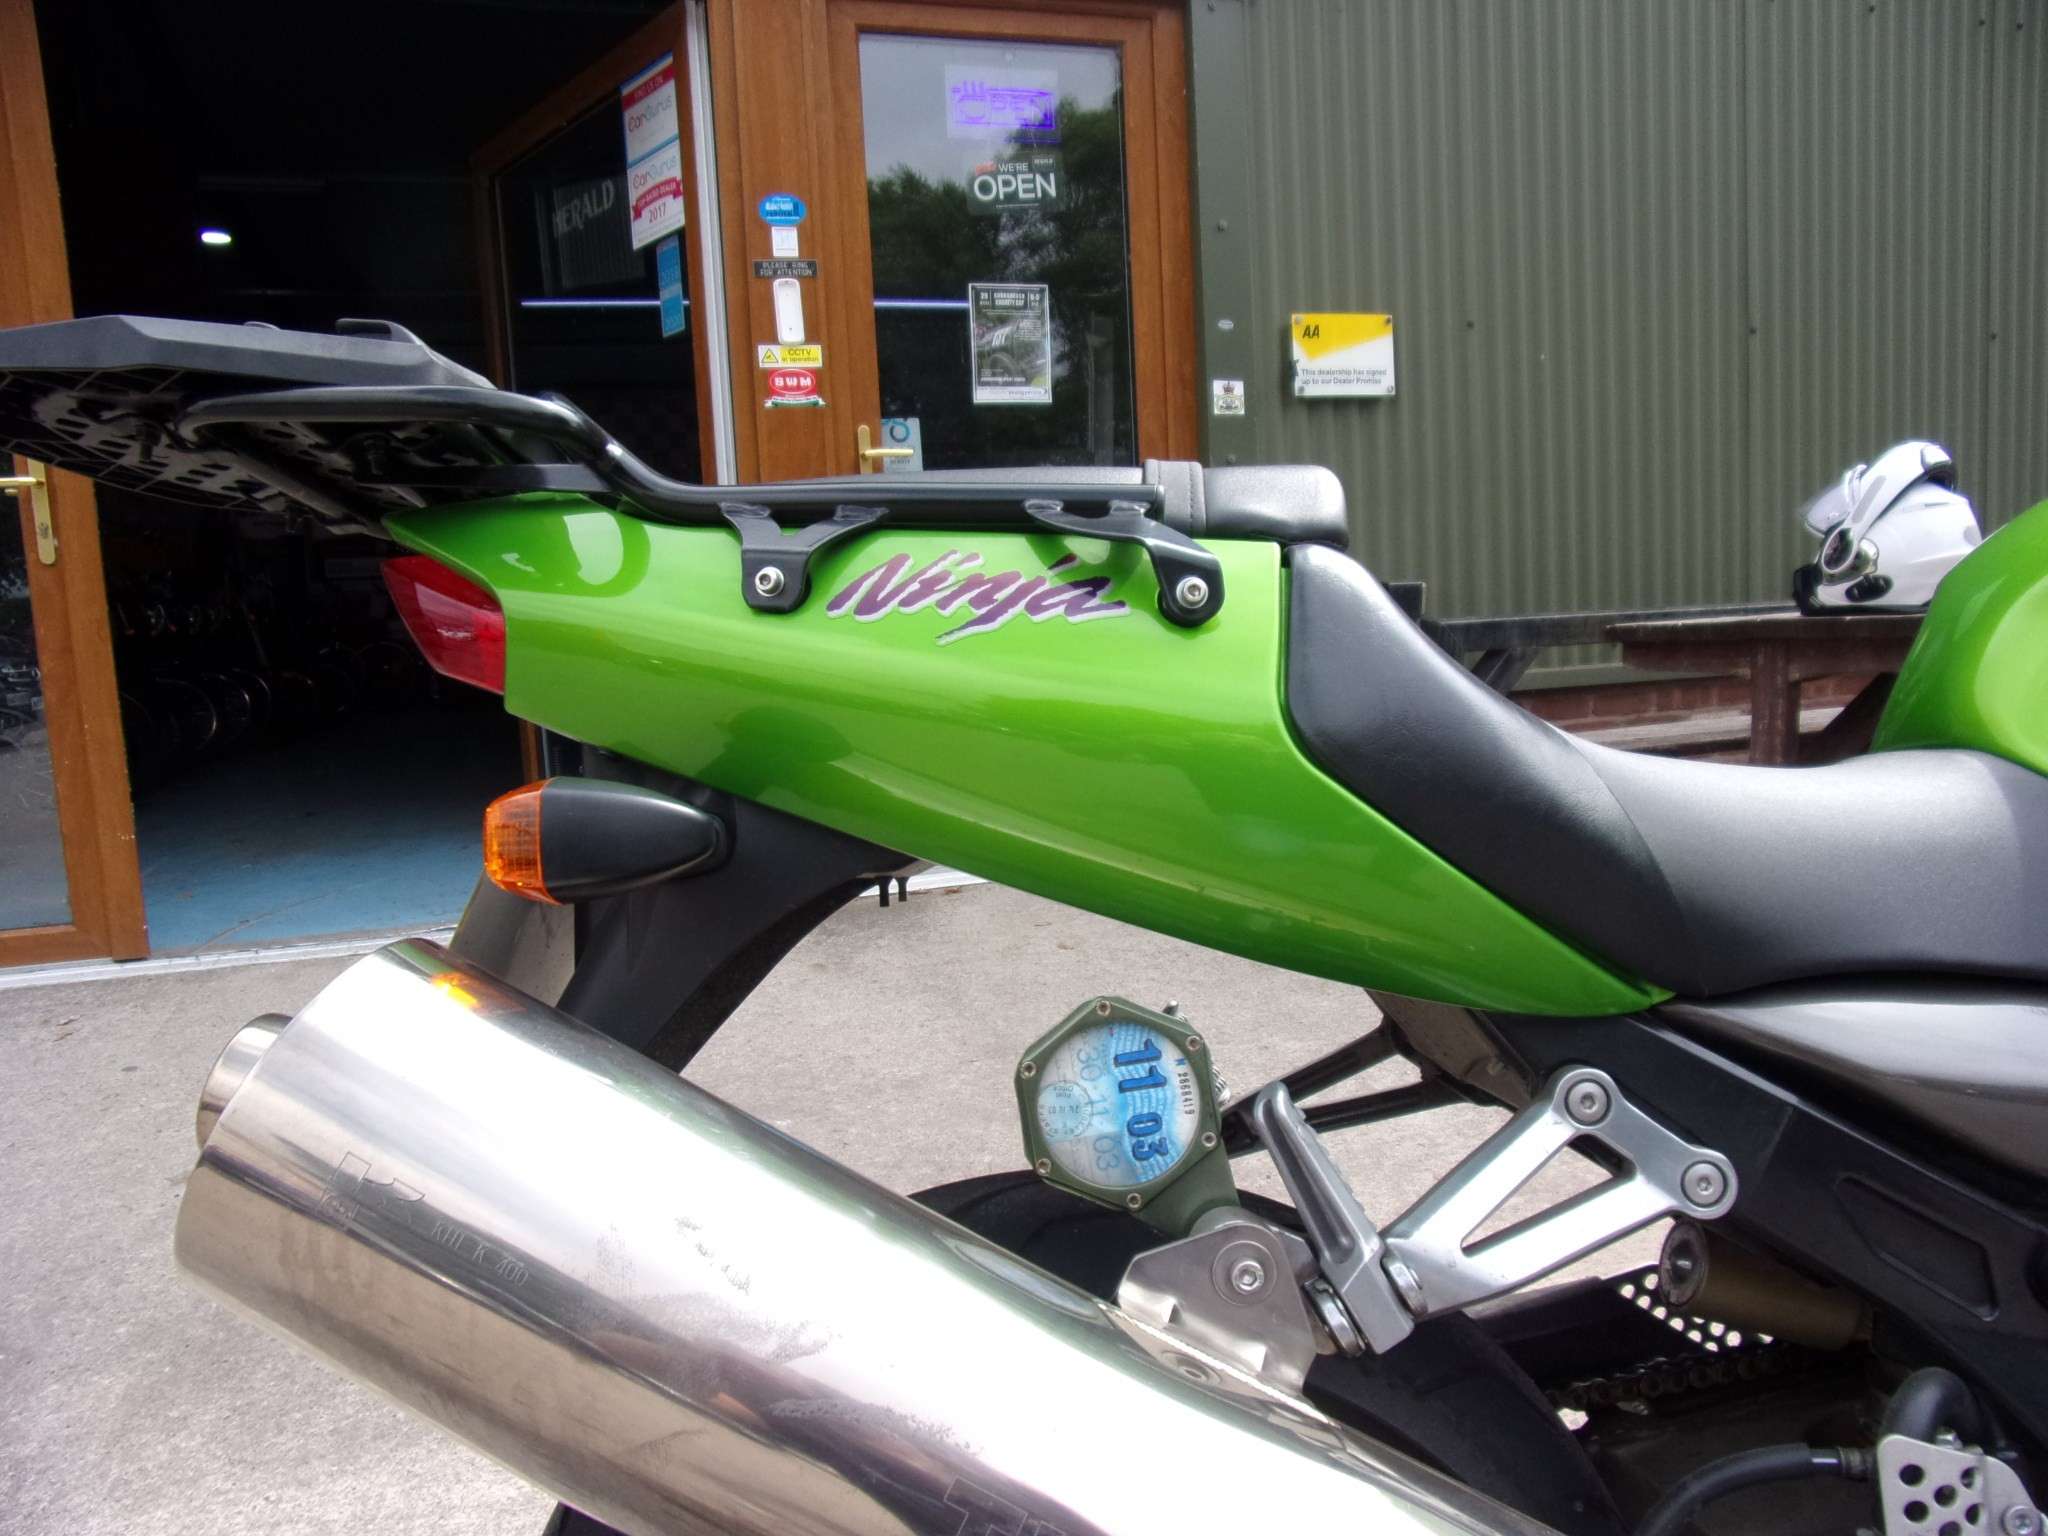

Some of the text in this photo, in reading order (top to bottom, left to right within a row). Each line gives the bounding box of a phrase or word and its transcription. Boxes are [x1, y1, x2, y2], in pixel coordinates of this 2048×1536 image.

[974, 172, 1057, 201] OPEN
[552, 180, 615, 237] HERALD
[648, 202, 668, 224] 2017
[1302, 324, 1320, 339] AA
[788, 348, 812, 357] CCTV
[1301, 368, 1387, 377] This dealership has signed
[826, 548, 1132, 648] Ninja
[1127, 1111, 1169, 1161] 03
